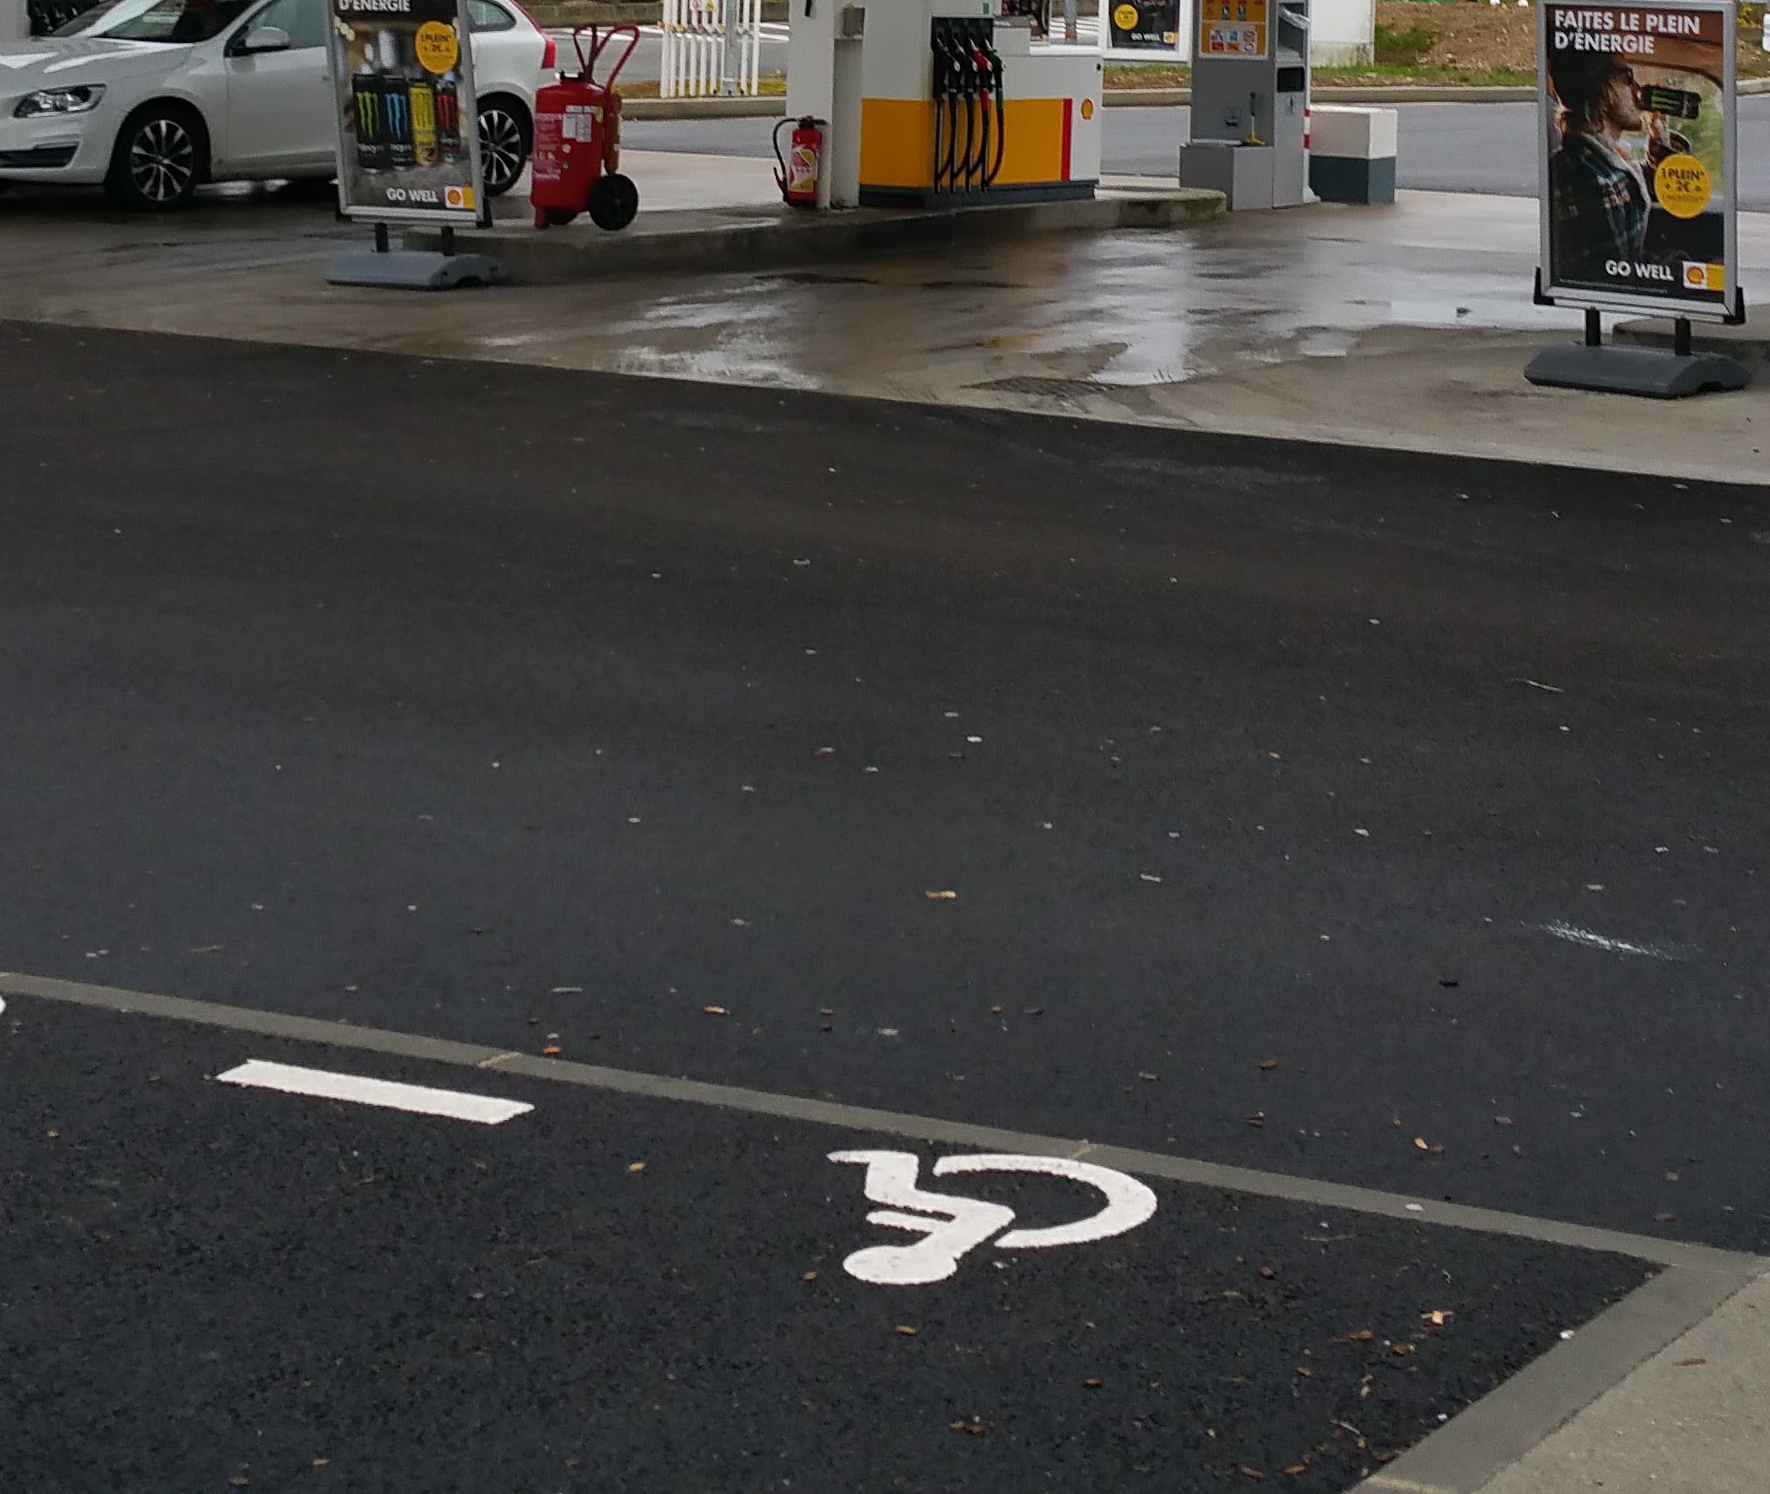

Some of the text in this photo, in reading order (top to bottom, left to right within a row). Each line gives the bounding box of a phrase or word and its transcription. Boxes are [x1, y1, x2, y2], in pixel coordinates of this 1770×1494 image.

[1554, 9, 1701, 36] FAITES LE PLEIN
[1554, 27, 1655, 55] D'ÉNERGIE
[386, 187, 439, 204] GO WELL
[1606, 260, 1674, 281] GO WELL
